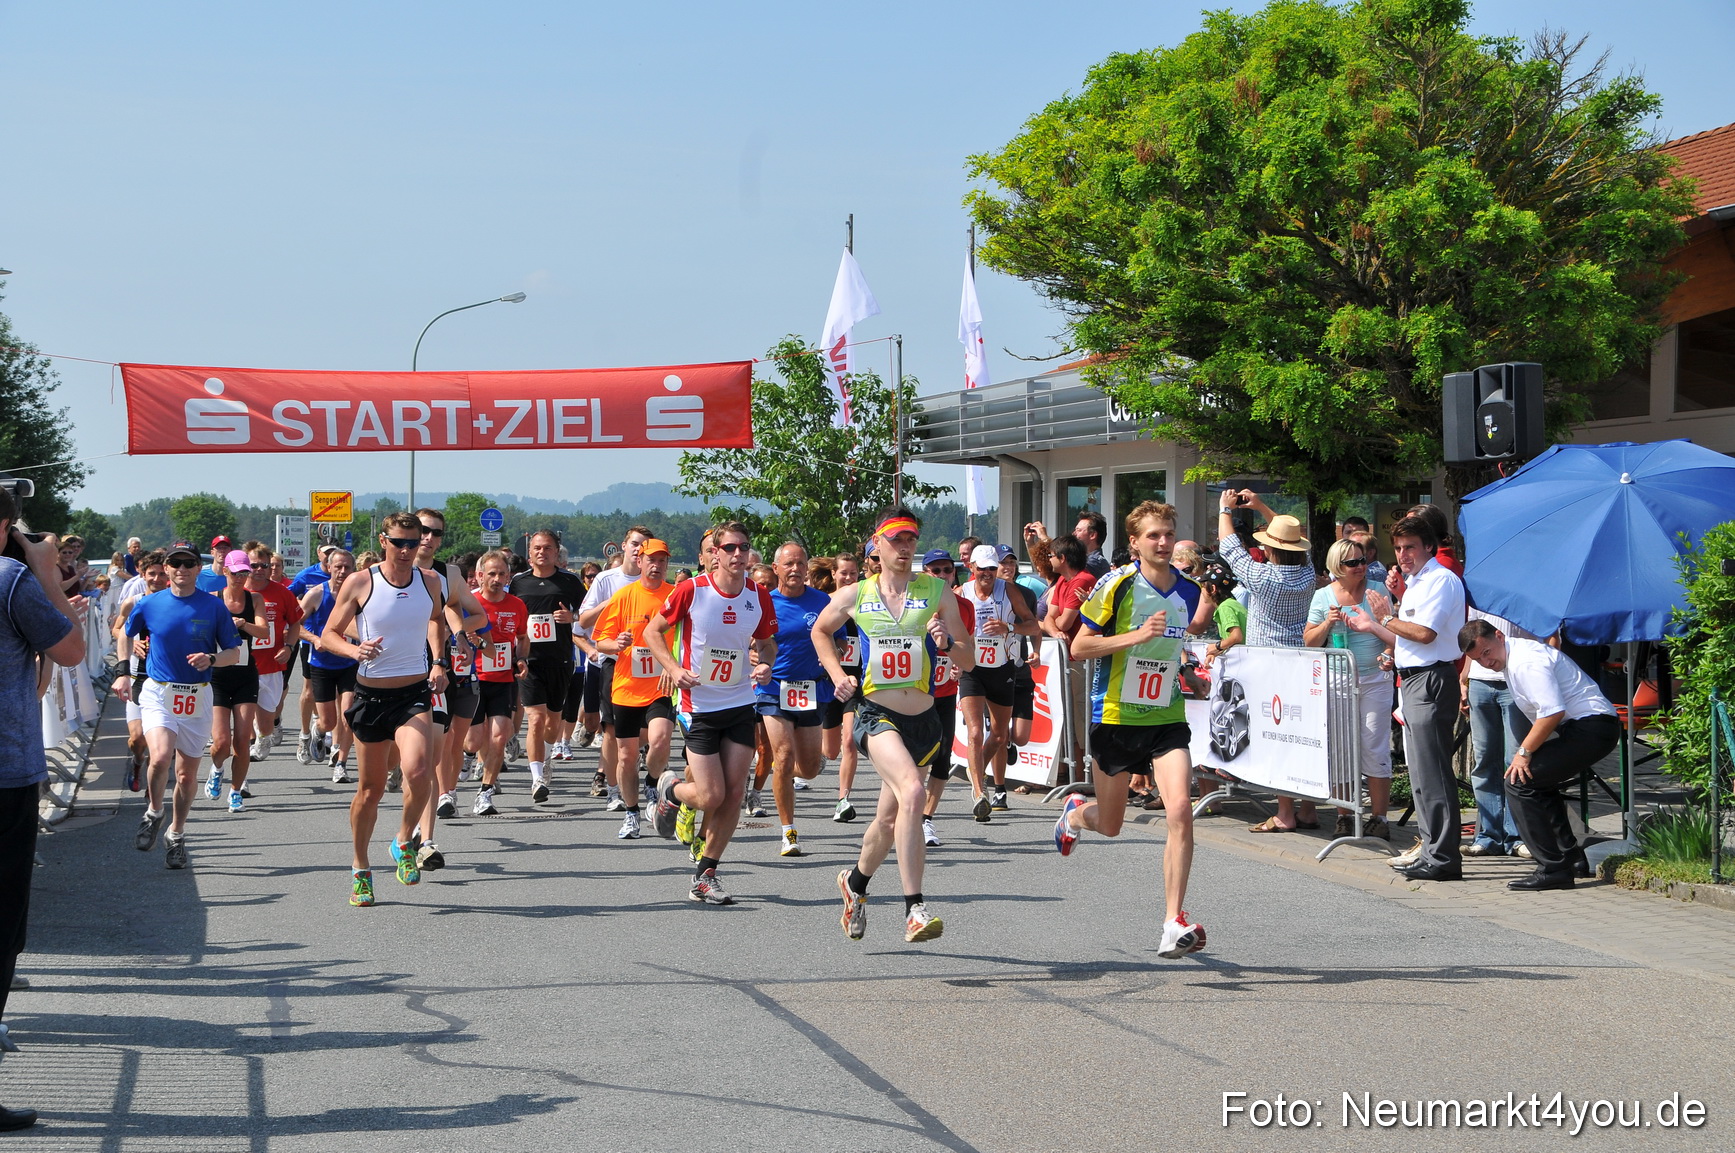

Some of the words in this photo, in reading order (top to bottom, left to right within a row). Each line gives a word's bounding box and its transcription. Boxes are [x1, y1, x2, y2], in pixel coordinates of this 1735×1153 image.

[533, 622, 551, 639] 30
[492, 651, 506, 668] 15
[710, 648, 730, 656] MEYER
[840, 644, 854, 663] 2
[979, 646, 996, 665] 73
[640, 656, 654, 675] 11
[709, 658, 733, 683] 79
[881, 651, 912, 680] 99
[1136, 659, 1159, 668] MEYER
[1138, 672, 1163, 700] 10
[172, 694, 197, 716] 56
[787, 688, 809, 708] 85
[1018, 751, 1053, 769] SEAT
